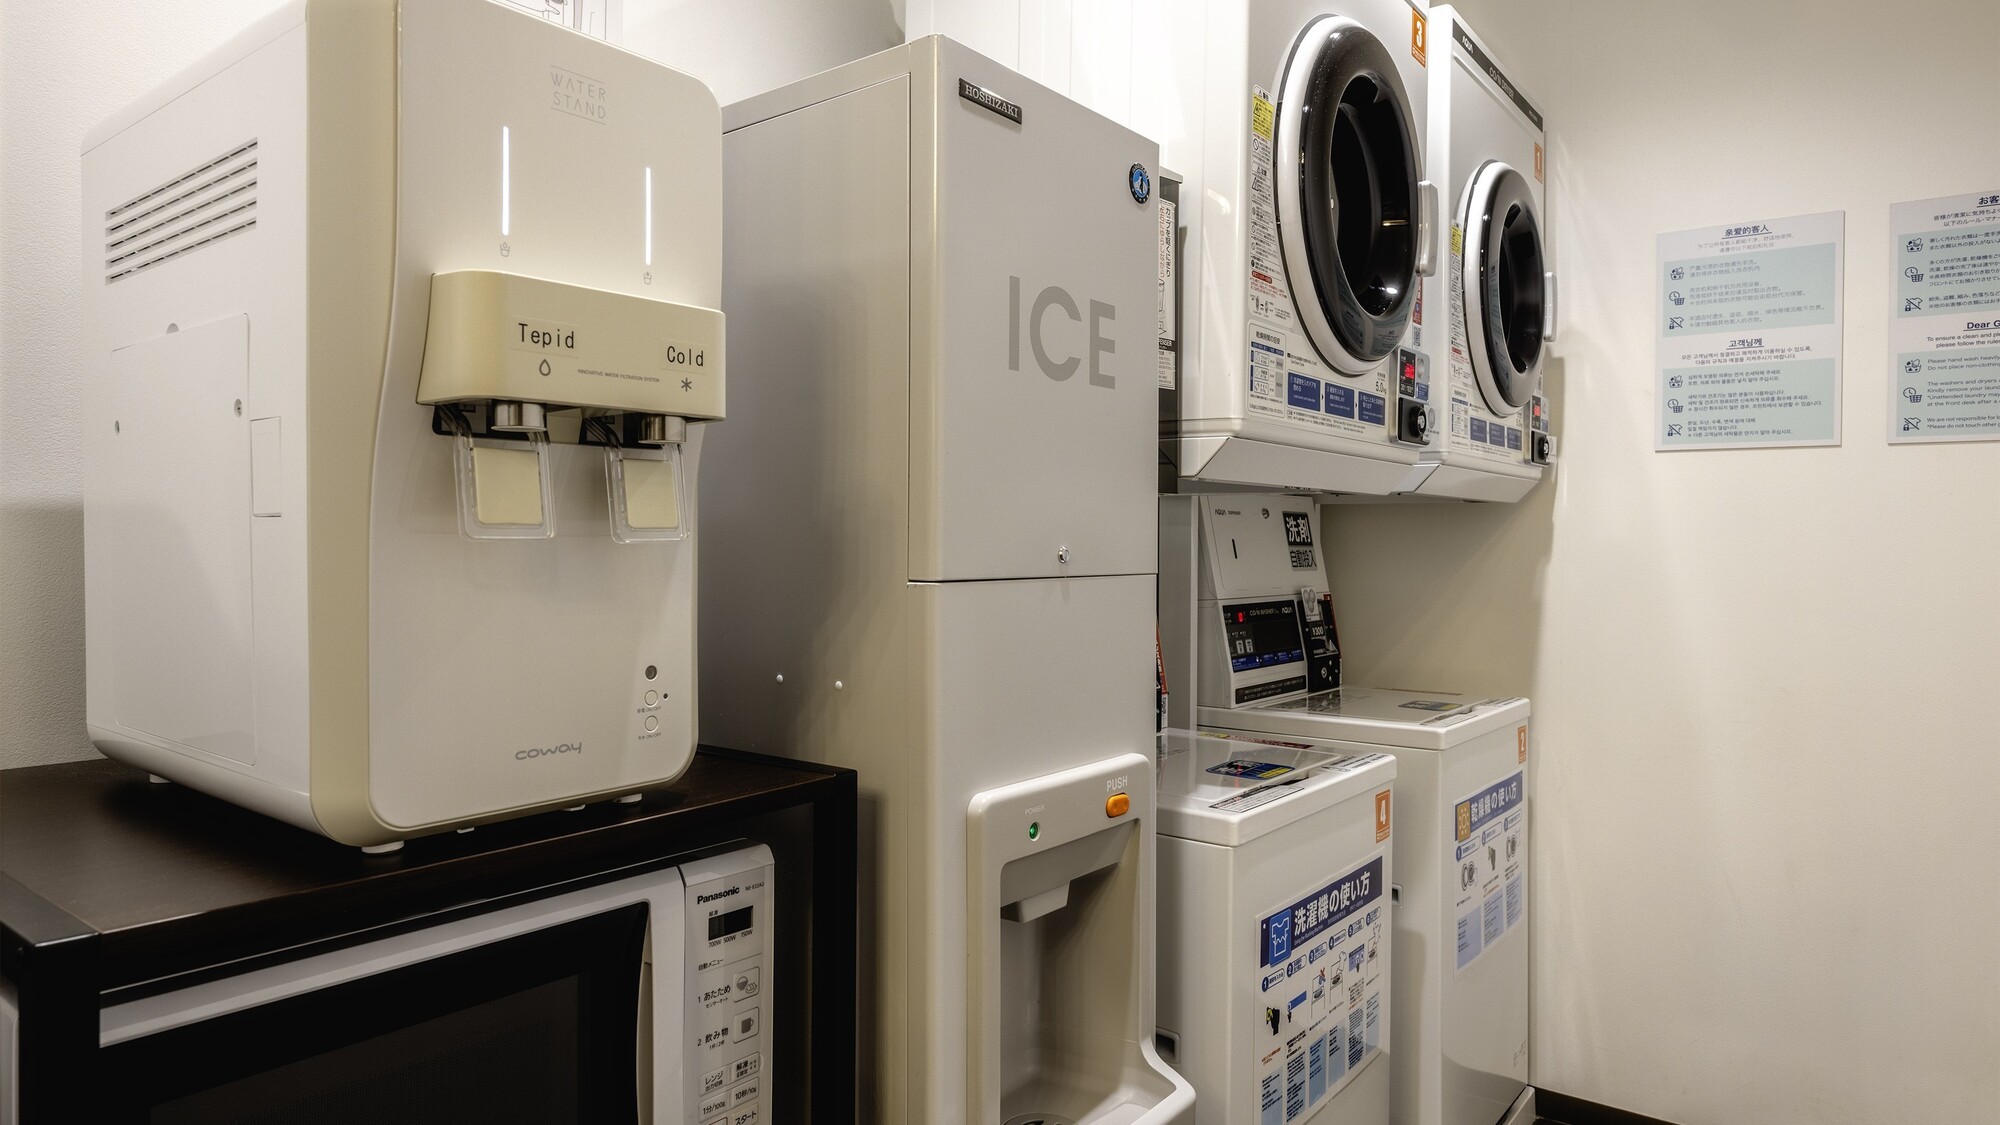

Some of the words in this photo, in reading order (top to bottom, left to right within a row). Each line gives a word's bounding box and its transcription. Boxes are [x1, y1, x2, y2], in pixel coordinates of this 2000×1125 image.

[1416, 21, 1422, 48] 3
[551, 72, 606, 102] WATER
[553, 92, 606, 119] STAND
[965, 84, 1018, 118] HOSHIZAKI
[1725, 224, 1769, 236] 亲爱的客人
[518, 323, 574, 349] Tepid
[1008, 275, 1115, 389] ICE
[1729, 338, 1762, 347] 고객님께
[667, 346, 704, 367] Cold
[1286, 516, 1311, 543] 洗剤
[1290, 550, 1317, 568] 自動投入
[1312, 627, 1323, 636] ¥300
[1521, 733, 1525, 751] 2
[515, 742, 582, 761] coway
[1106, 776, 1127, 792] PUSH
[1025, 805, 1044, 815] POWER
[1380, 800, 1386, 825] 4
[697, 886, 740, 904] Panasonic
[1294, 871, 1370, 936] 洗濯機の使い方
[723, 935, 736, 944] 500W
[704, 985, 730, 1001] あたため
[705, 1028, 728, 1043] 飲み物
[705, 1071, 723, 1085] レンジ
[735, 1087, 757, 1100] 10秒/10g
[703, 1101, 725, 1115] 1分/100g
[735, 1111, 756, 1125] スタート
